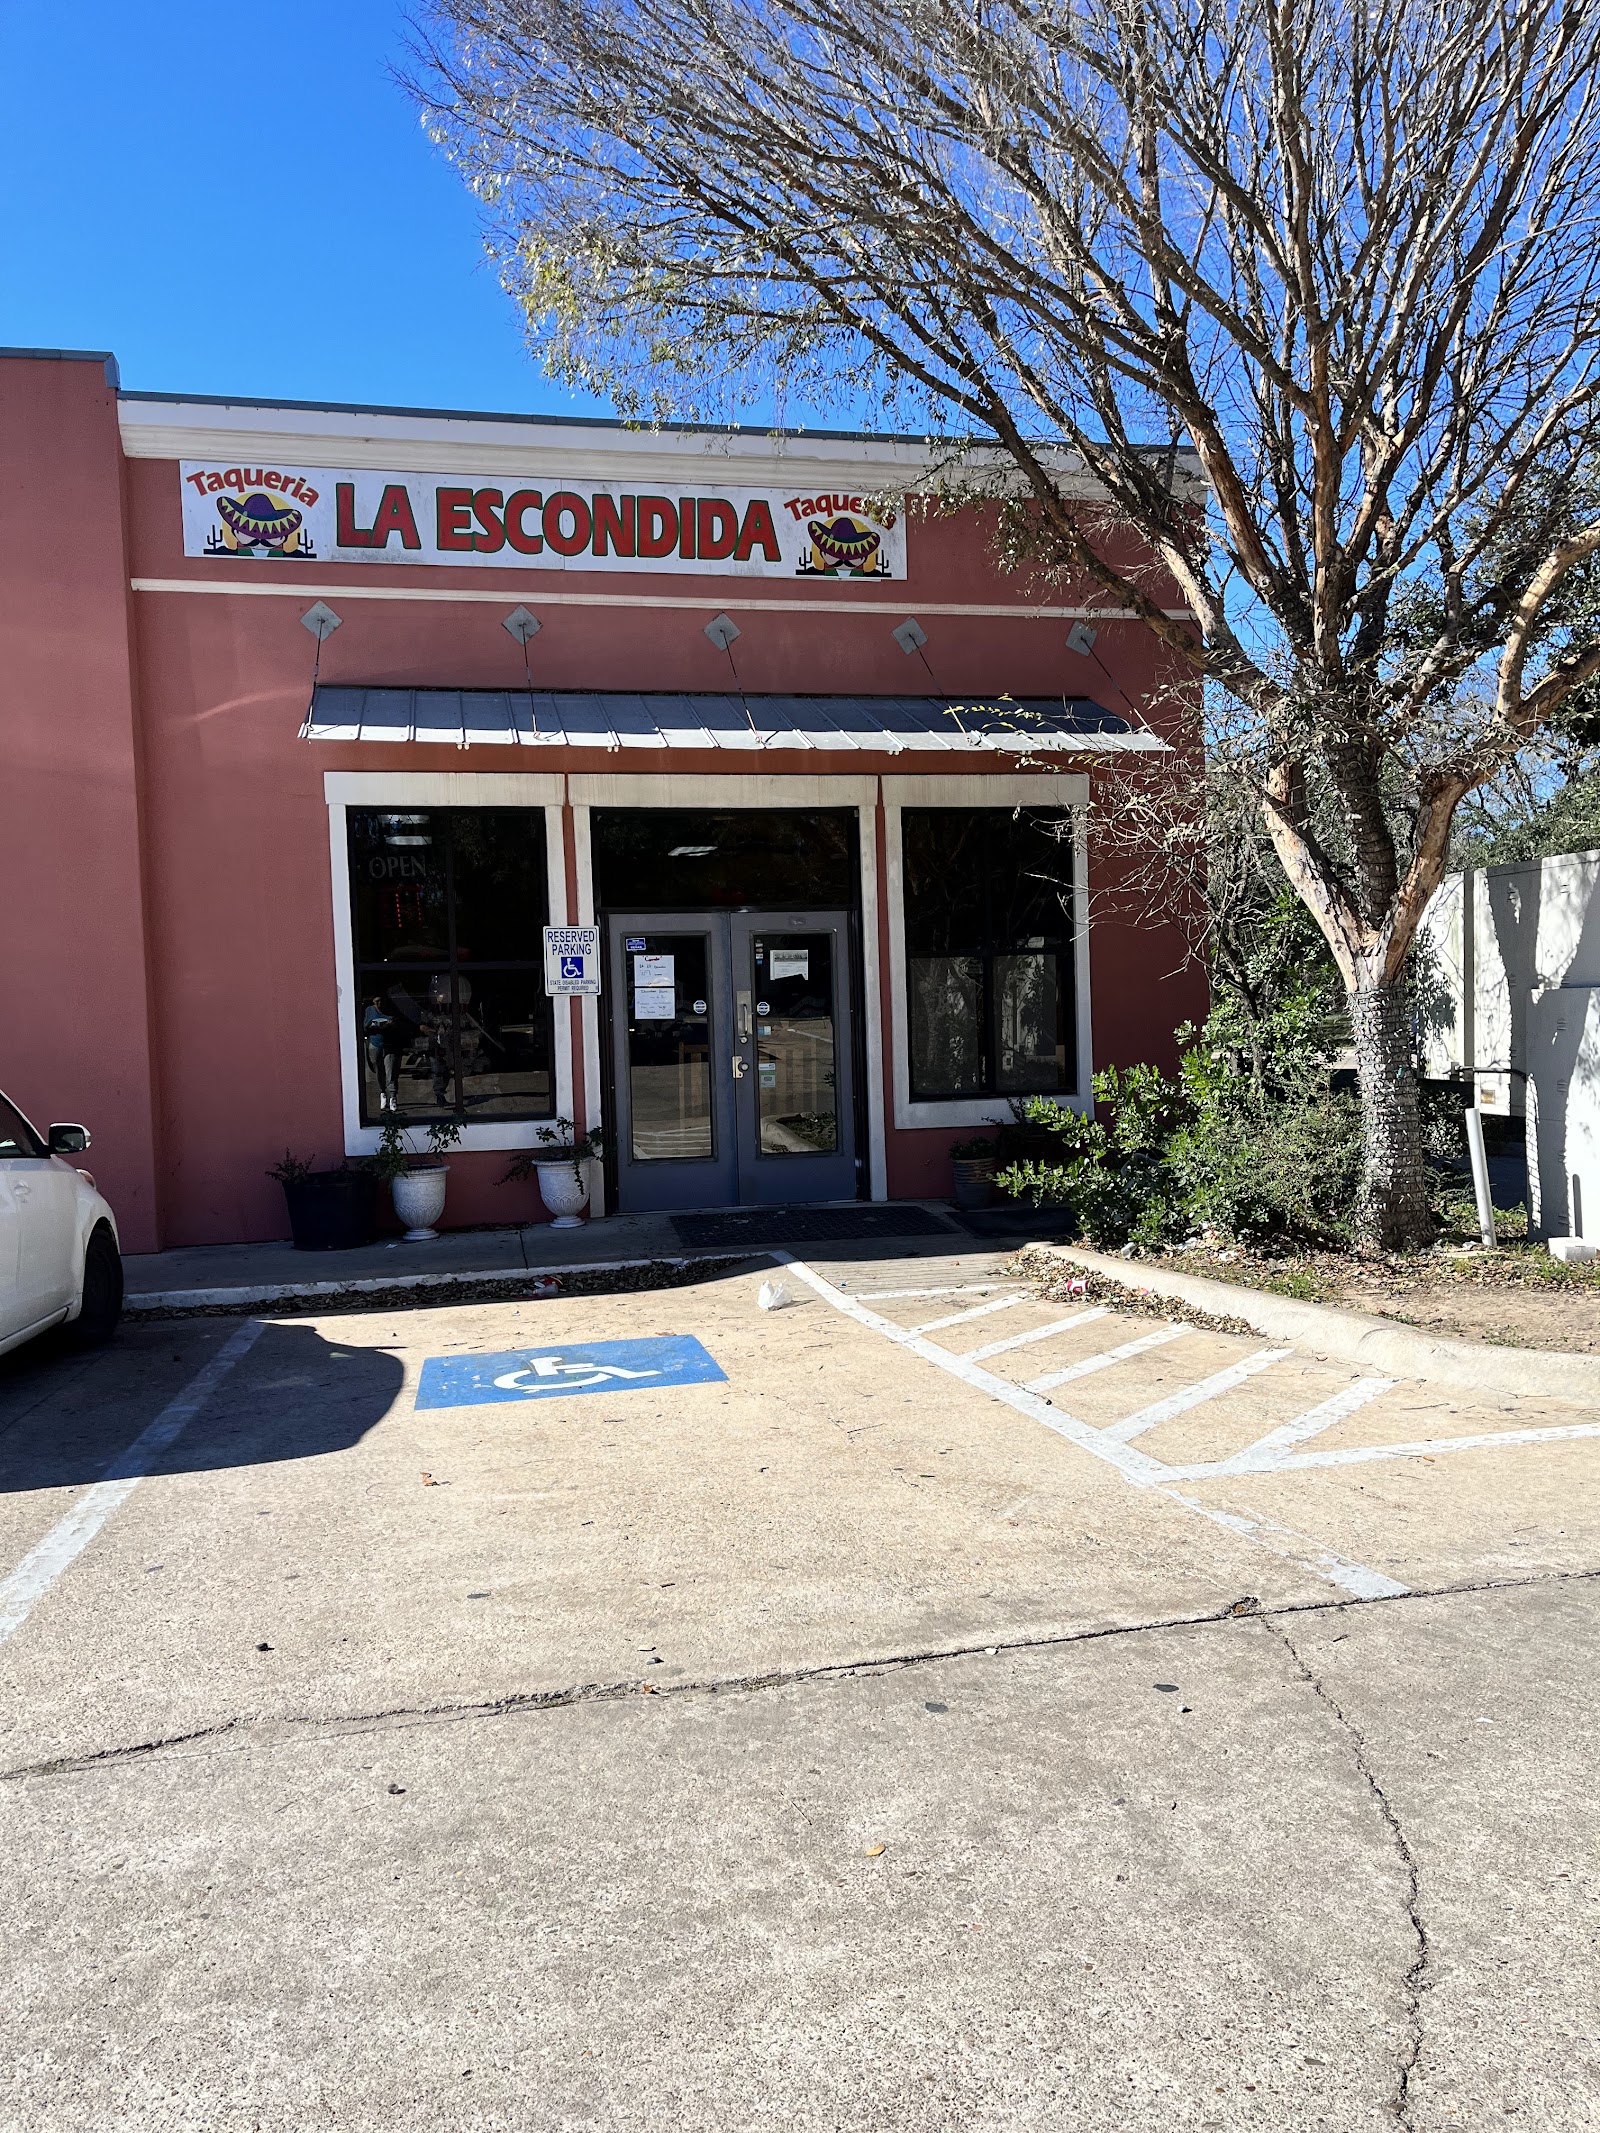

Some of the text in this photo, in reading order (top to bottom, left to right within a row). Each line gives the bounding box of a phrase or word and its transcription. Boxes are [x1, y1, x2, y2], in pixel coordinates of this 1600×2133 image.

[186, 467, 320, 508] Taqueria
[336, 482, 782, 562] LA ESCONDIDA
[783, 494, 896, 530] Taque
[369, 855, 426, 878] OPEN
[547, 931, 595, 943] RESERVED
[552, 944, 592, 956] PARKING
